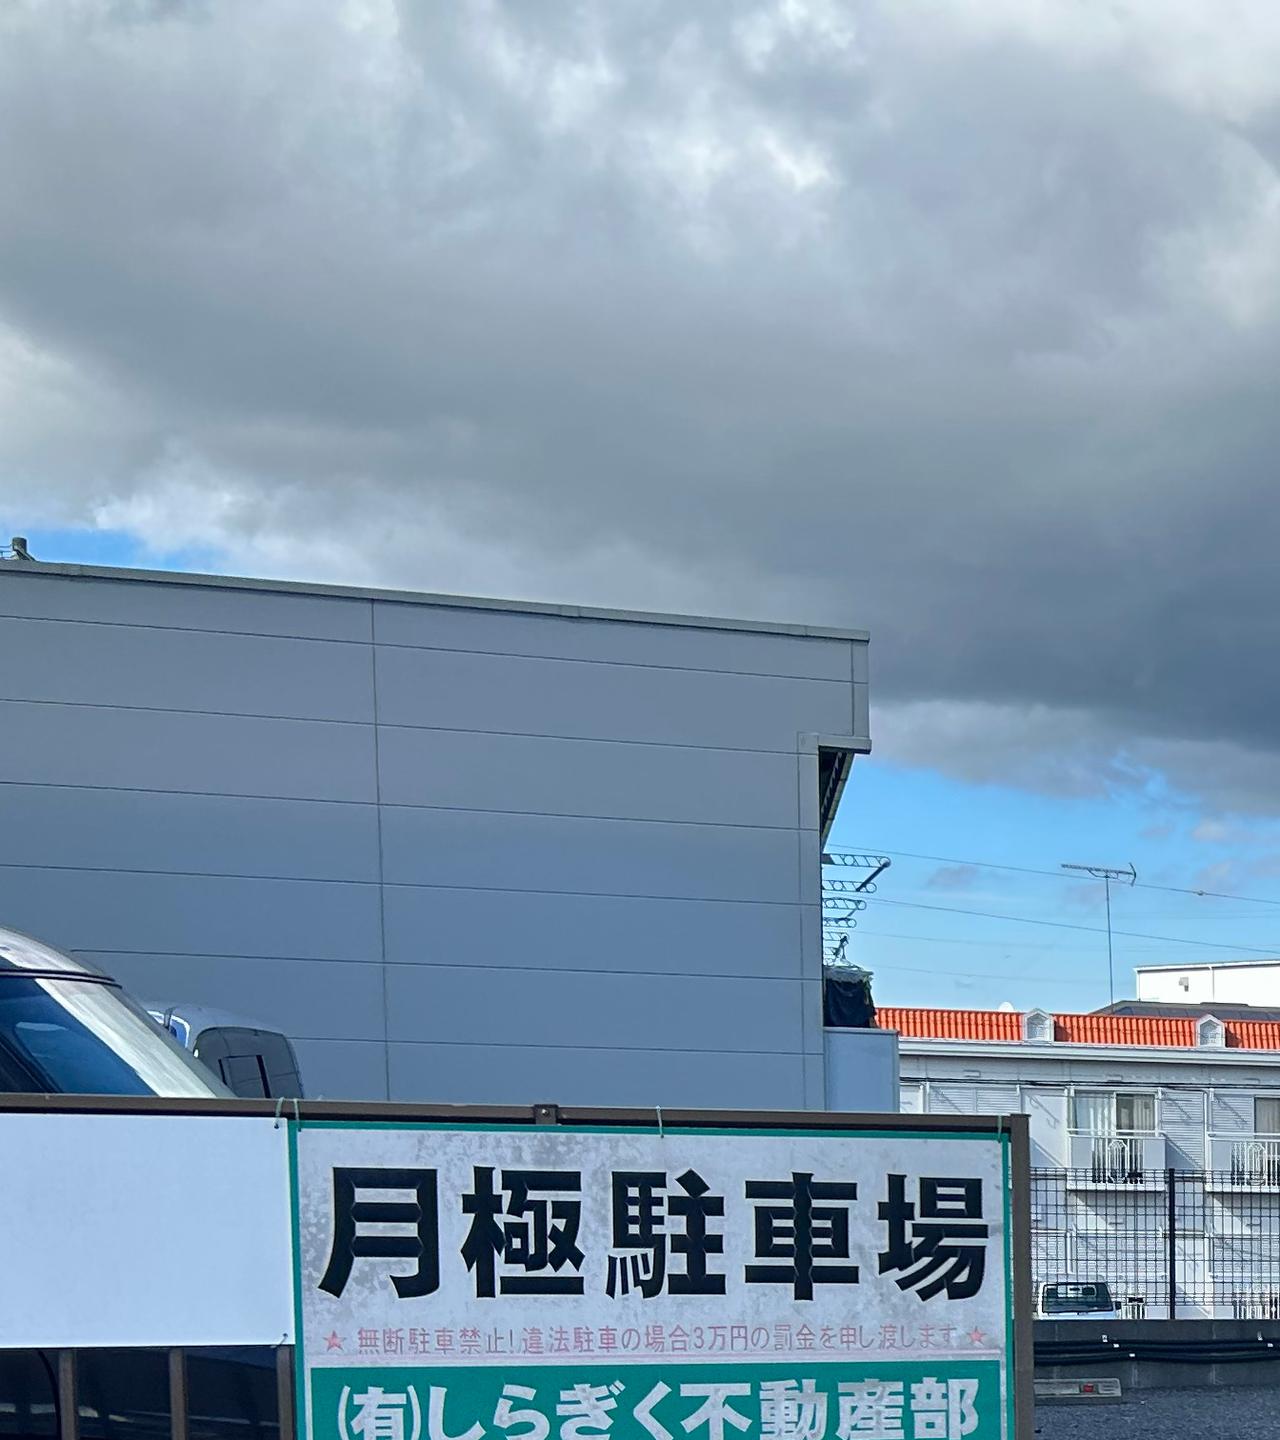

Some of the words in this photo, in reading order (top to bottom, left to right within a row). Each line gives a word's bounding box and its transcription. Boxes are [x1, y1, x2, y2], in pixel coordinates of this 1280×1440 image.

[318, 1166, 989, 1301] 月極駐車場
